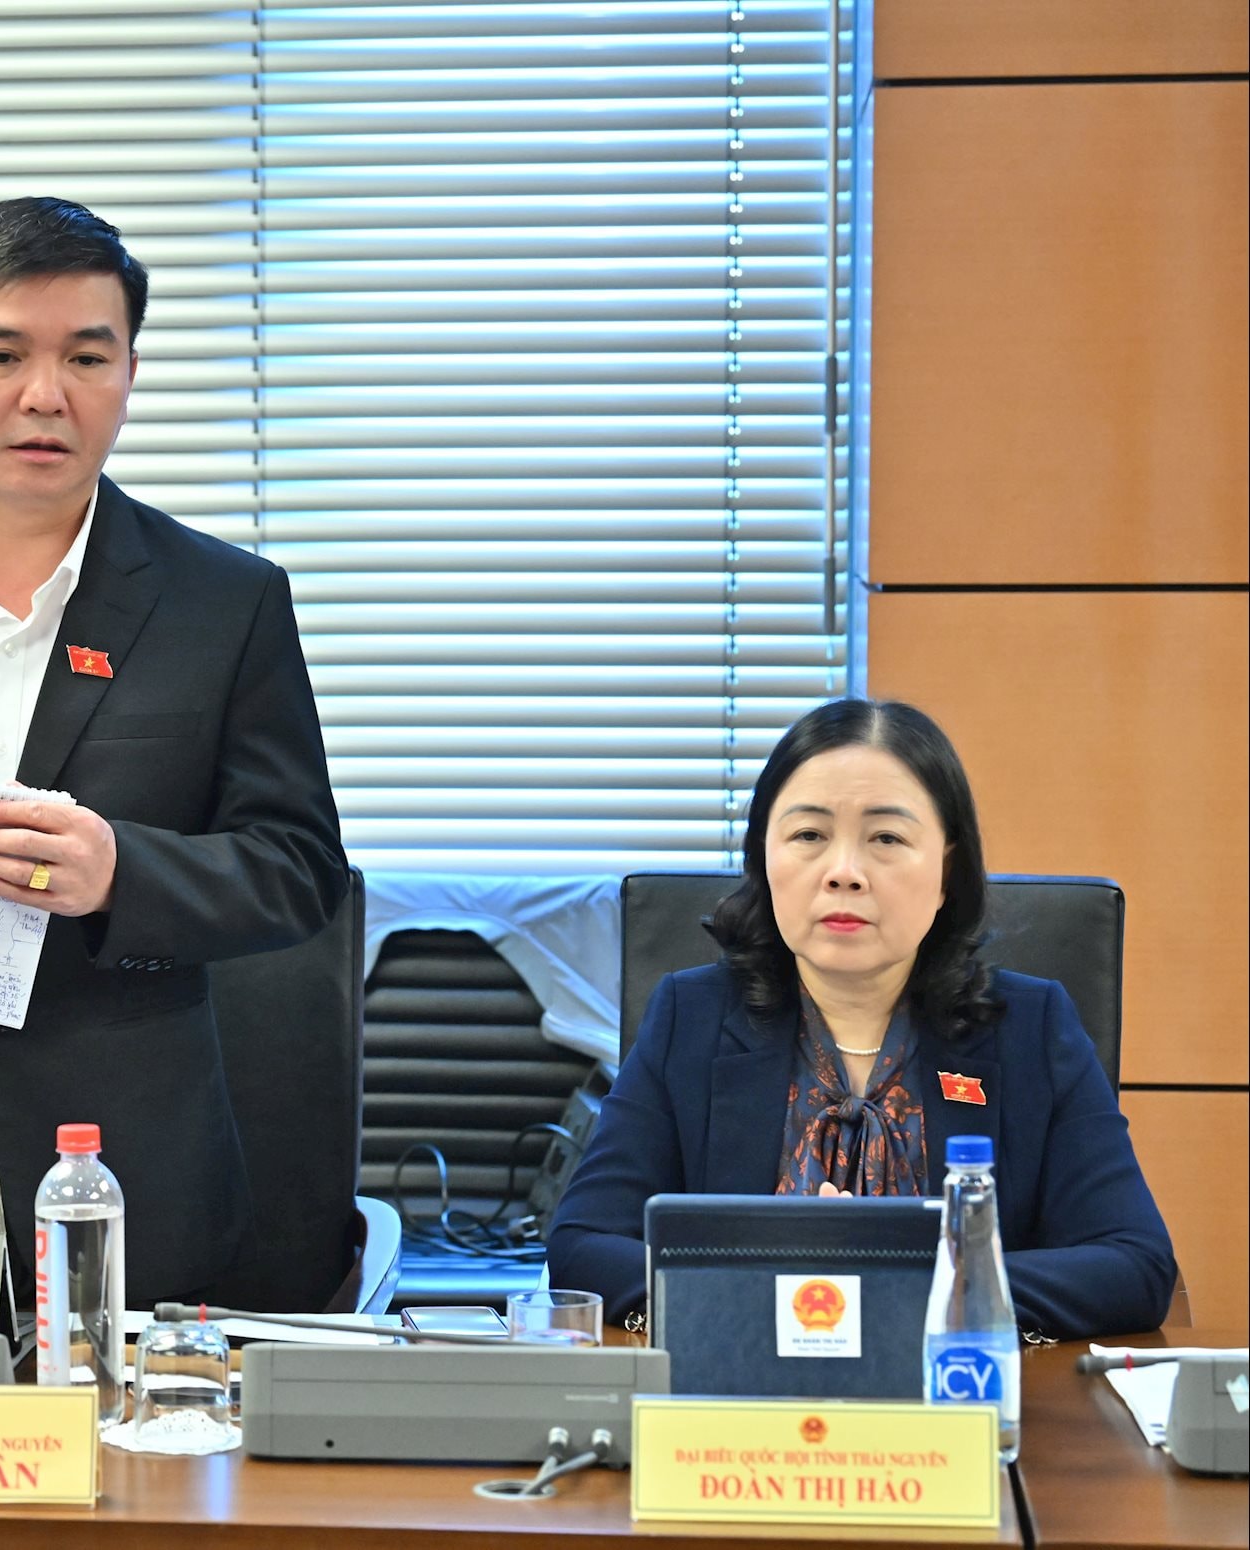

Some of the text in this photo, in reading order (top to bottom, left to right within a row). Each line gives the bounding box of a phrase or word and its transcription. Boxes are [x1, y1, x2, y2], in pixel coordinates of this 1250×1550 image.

[936, 1362, 993, 1399] ICY
[1, 1437, 63, 1451] NGUYÊN
[700, 1468, 923, 1508] ĐOÀN THỊ HẢO
